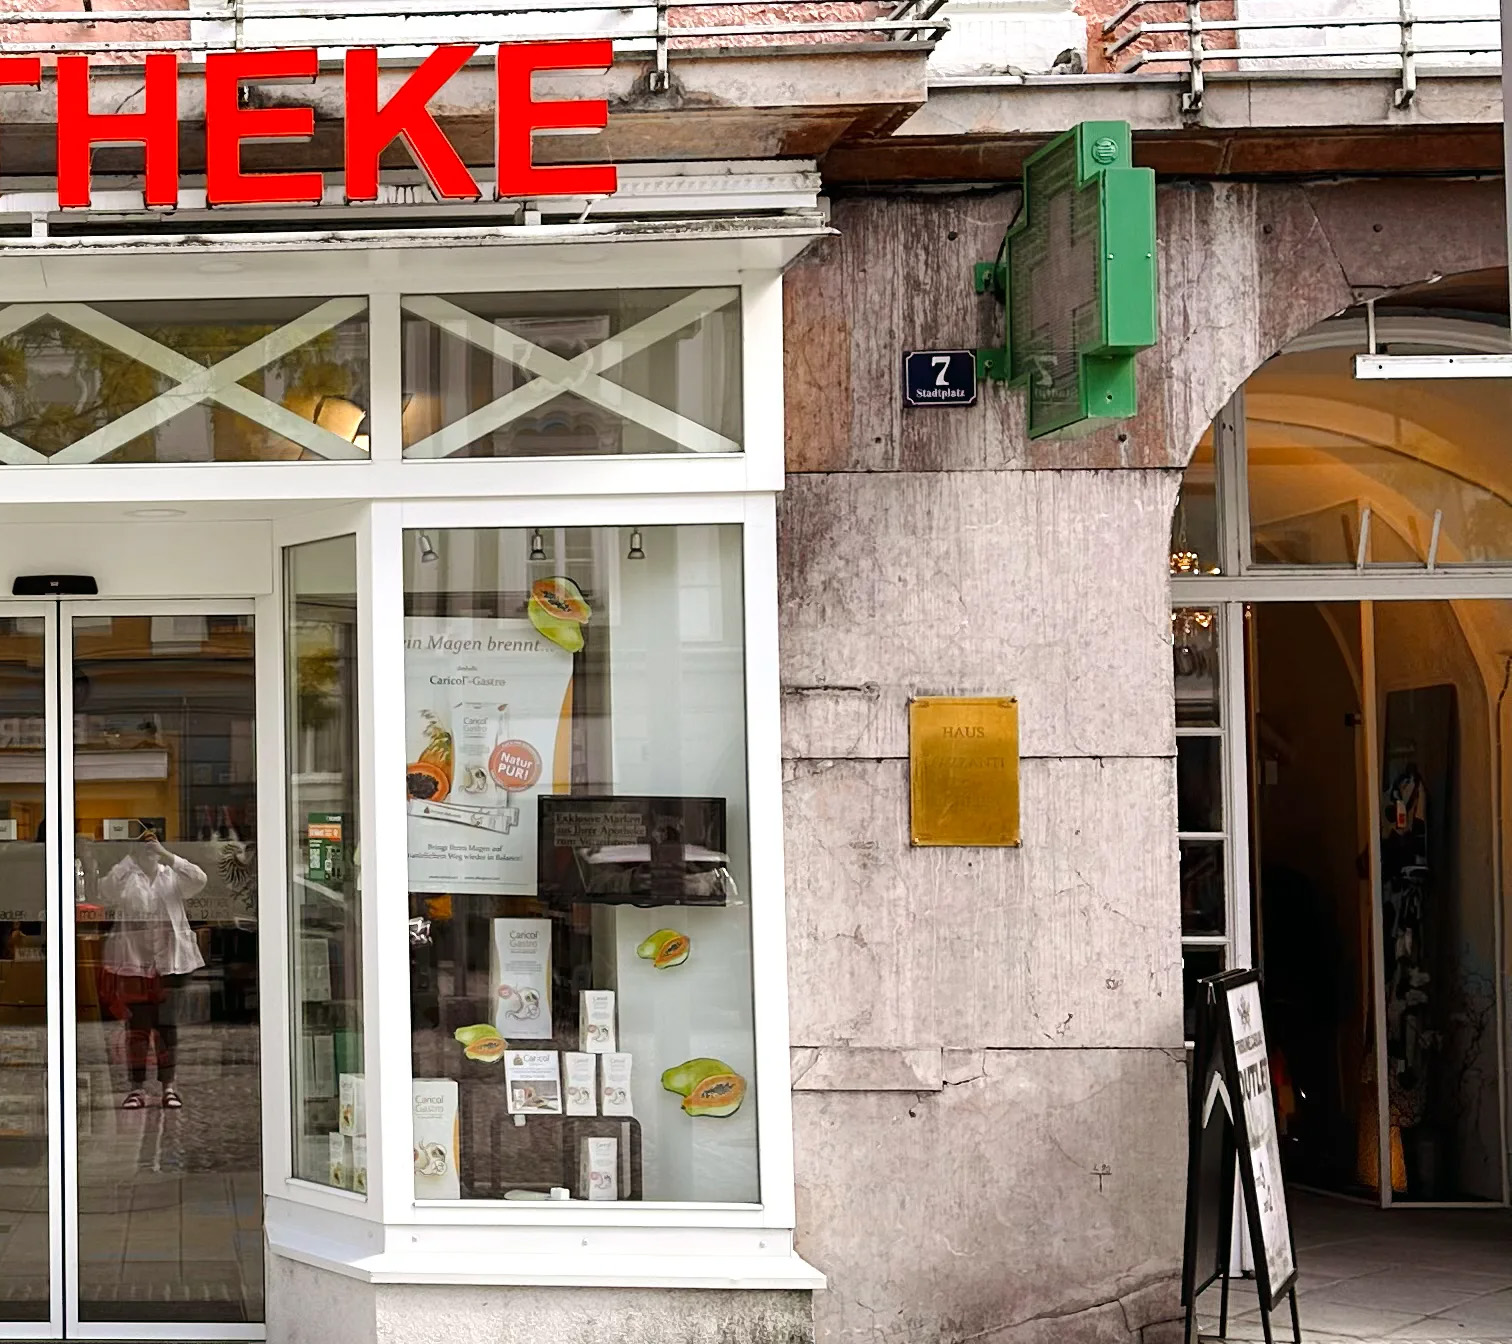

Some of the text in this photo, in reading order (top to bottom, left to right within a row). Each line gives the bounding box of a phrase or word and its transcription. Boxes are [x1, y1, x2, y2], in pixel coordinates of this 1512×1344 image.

[932, 356, 951, 386] 7
[916, 388, 965, 400] Stadtplatz
[427, 635, 481, 654] Magen
[943, 726, 985, 738] HAUS
[500, 752, 533, 769] Natur
[498, 763, 529, 781] PUR!
[509, 930, 538, 940] Caricol
[415, 1095, 444, 1104] Caricol
